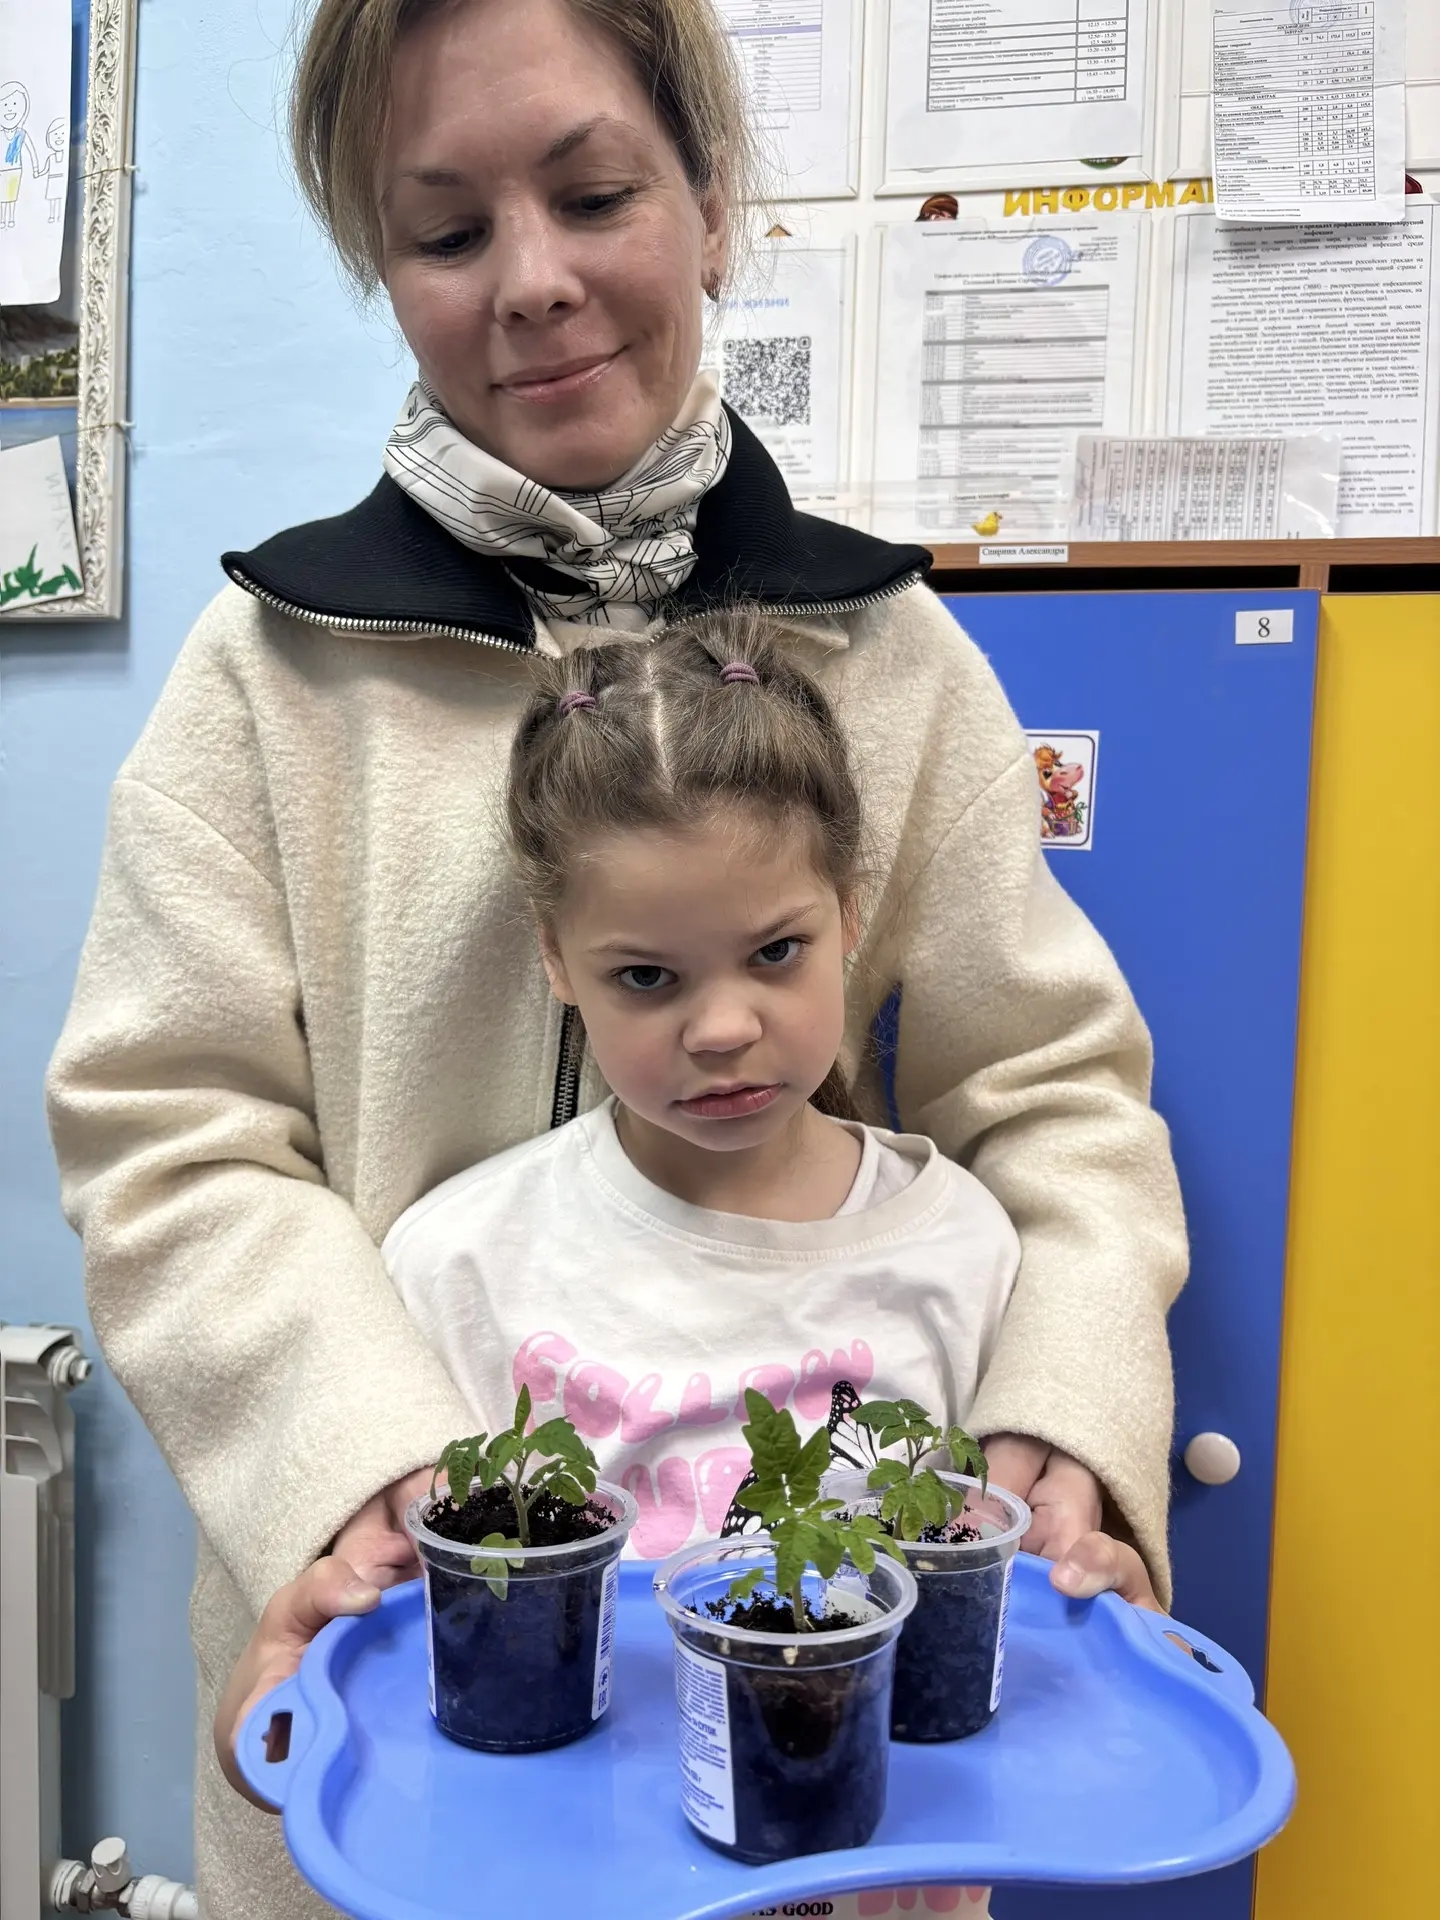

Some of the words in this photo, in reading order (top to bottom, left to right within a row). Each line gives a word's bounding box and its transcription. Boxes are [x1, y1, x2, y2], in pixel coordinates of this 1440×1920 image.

[1018, 548, 1065, 556] Александра
[1258, 617, 1270, 638] 8
[513, 1331, 874, 1443] FOLLOW
[782, 1902, 834, 1916] GOOD
